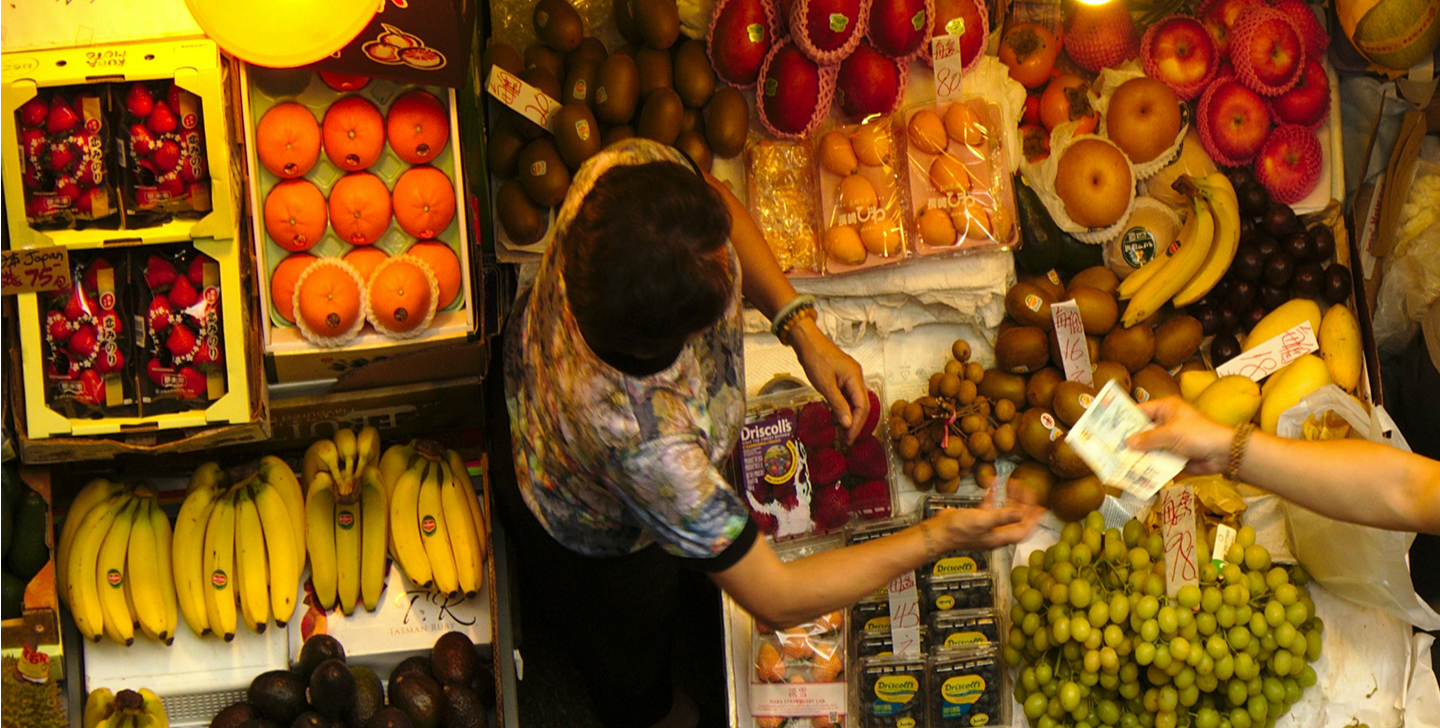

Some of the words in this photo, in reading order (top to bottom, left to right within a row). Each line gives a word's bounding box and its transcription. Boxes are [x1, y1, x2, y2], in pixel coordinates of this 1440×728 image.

[23, 251, 63, 268] Japan
[741, 418, 792, 441] Driscoll's
[1165, 531, 1197, 581] 98
[937, 563, 974, 573] Driscoll's
[389, 625, 427, 636] TASMAN
[431, 622, 455, 631] RUBY
[878, 681, 915, 689] Driscoll's
[945, 681, 981, 691] Driscoll's
